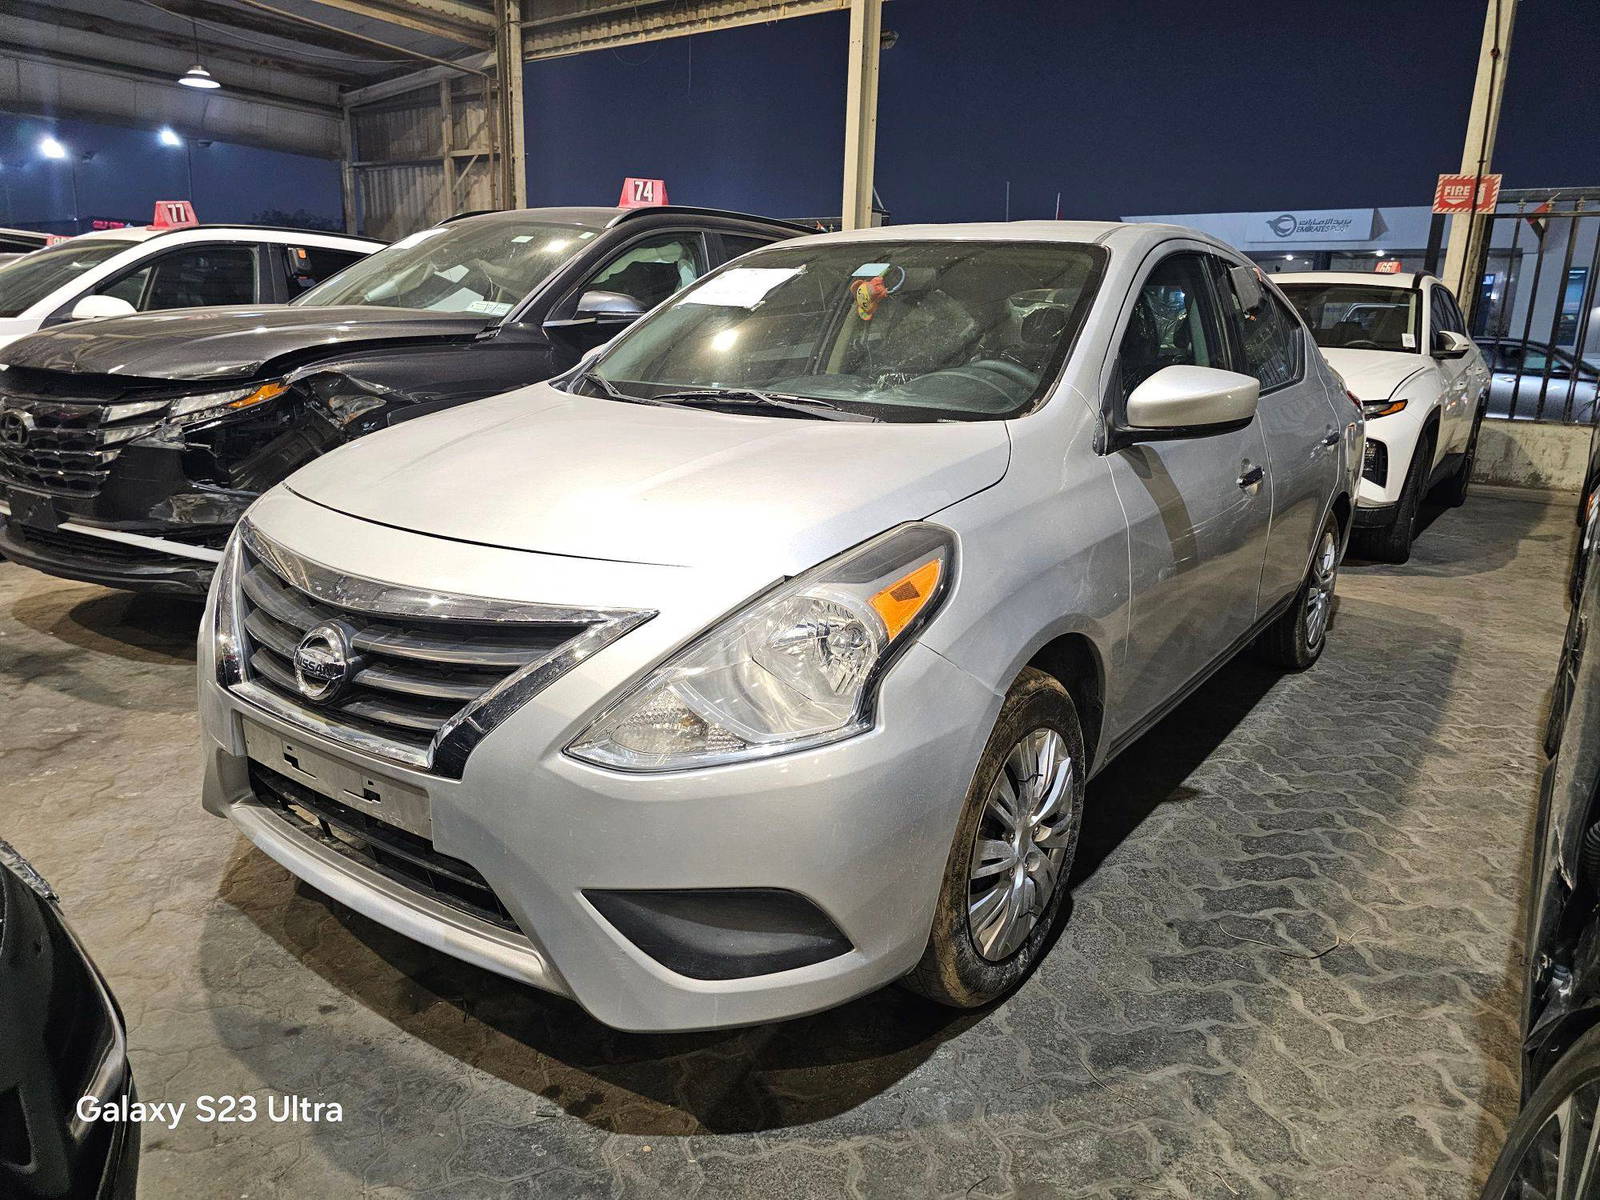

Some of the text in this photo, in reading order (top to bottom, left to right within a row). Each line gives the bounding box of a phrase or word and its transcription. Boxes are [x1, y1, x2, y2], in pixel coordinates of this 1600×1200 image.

[634, 181, 653, 202] 74
[1443, 185, 1470, 196] FIRE
[167, 203, 186, 222] 77
[1296, 225, 1330, 233] EMIRATES
[296, 651, 332, 674] NISSAN
